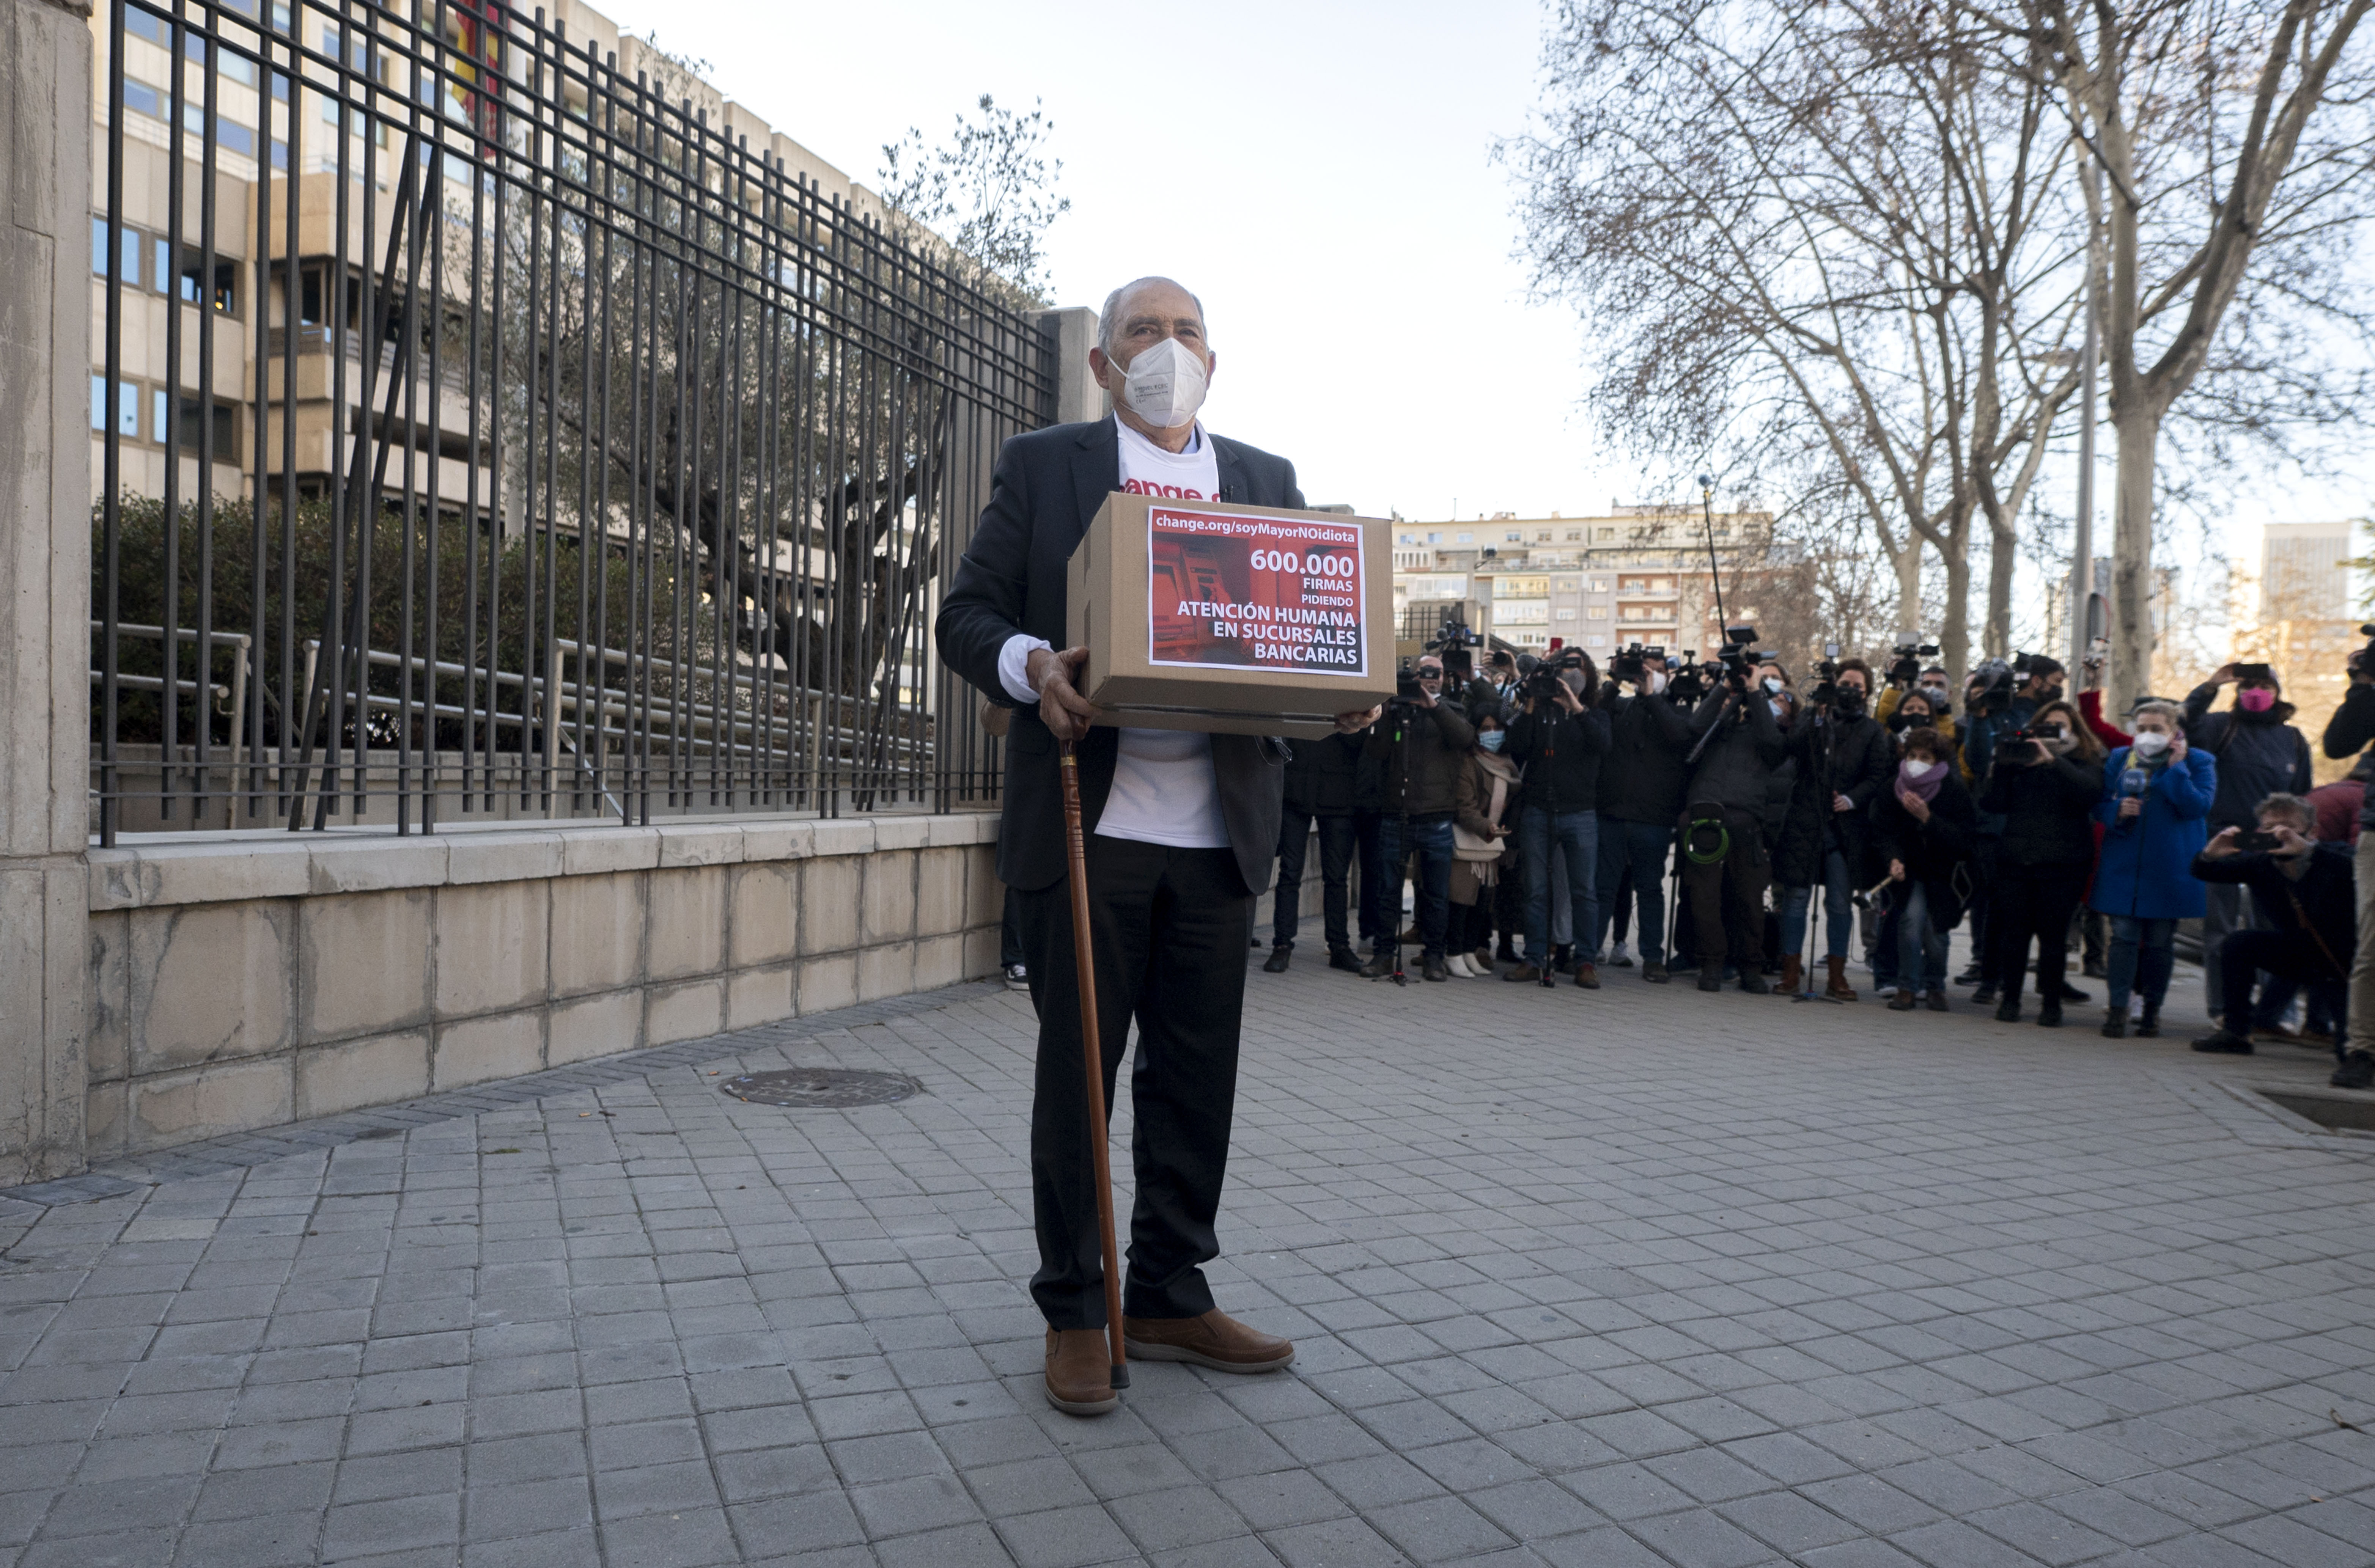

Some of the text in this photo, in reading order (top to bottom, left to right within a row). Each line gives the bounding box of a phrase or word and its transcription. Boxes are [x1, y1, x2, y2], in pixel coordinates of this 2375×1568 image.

[1156, 514, 1355, 543] change.org/soyMayorNOidiota
[1251, 549, 1354, 577] 600.000
[1303, 577, 1353, 592] FIRMAS
[1301, 594, 1354, 607] PIDIENDO
[1177, 600, 1356, 627] ATENCIÓN HUMANA
[1214, 621, 1356, 646] EN SUCURSALES
[1255, 643, 1357, 665] BANCARIAS
